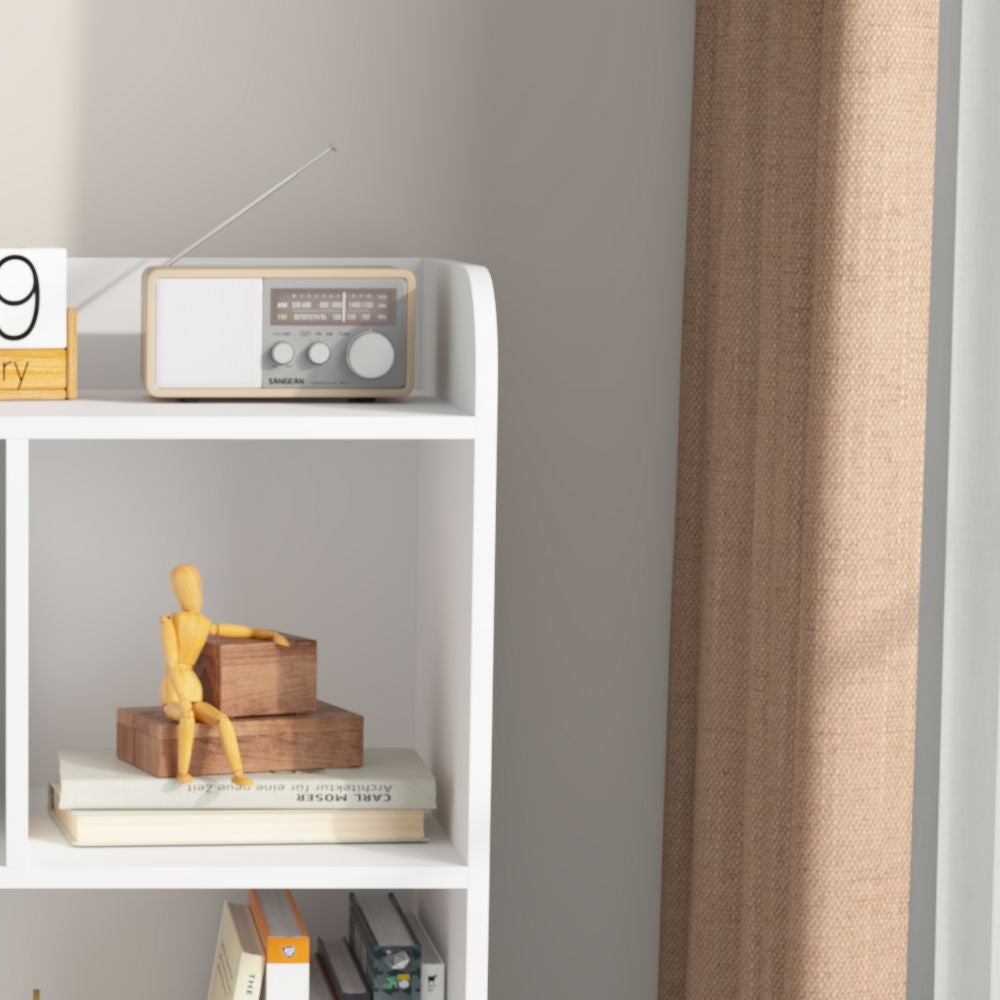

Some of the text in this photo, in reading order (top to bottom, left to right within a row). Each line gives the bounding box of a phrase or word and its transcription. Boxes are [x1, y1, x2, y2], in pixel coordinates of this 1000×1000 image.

[187, 783, 213, 793] Zeit
[256, 783, 285, 792] eine
[314, 783, 392, 793] Architektur
[296, 793, 392, 802] CARL MOSER
[245, 974, 256, 995] THE
